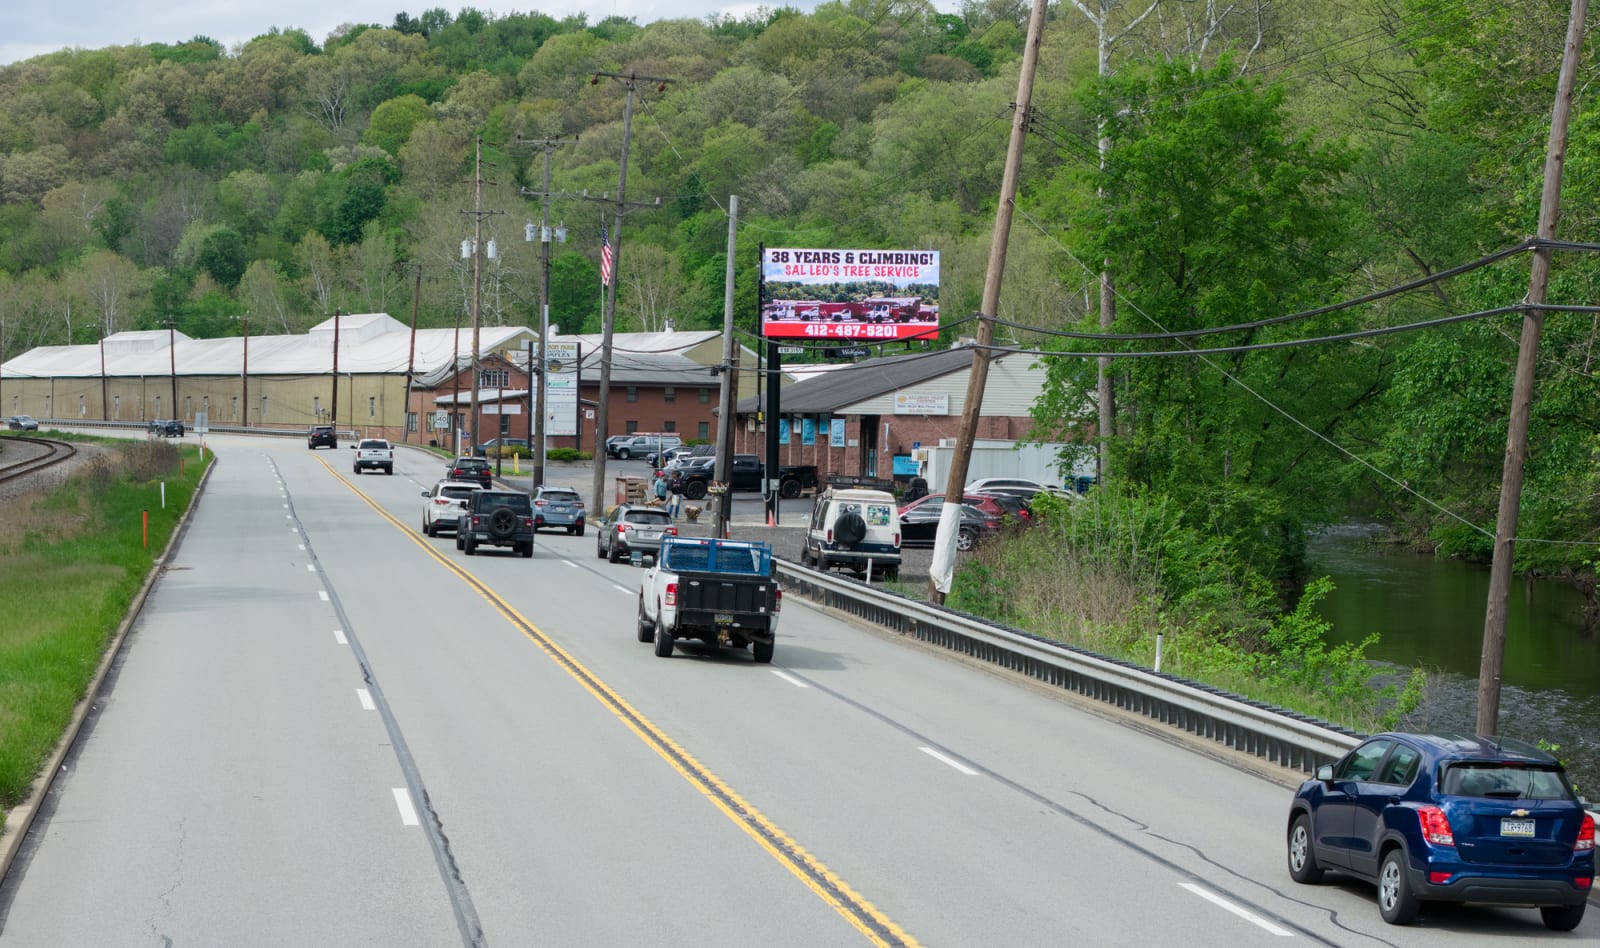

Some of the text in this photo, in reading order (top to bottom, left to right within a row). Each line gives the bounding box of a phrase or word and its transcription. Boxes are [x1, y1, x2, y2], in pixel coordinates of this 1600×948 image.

[771, 251, 933, 265] 38 YEARS & CLIMBING!
[785, 265, 919, 277] SAL LEO'S TREE SERVICE
[805, 325, 897, 337] 412-487-5201
